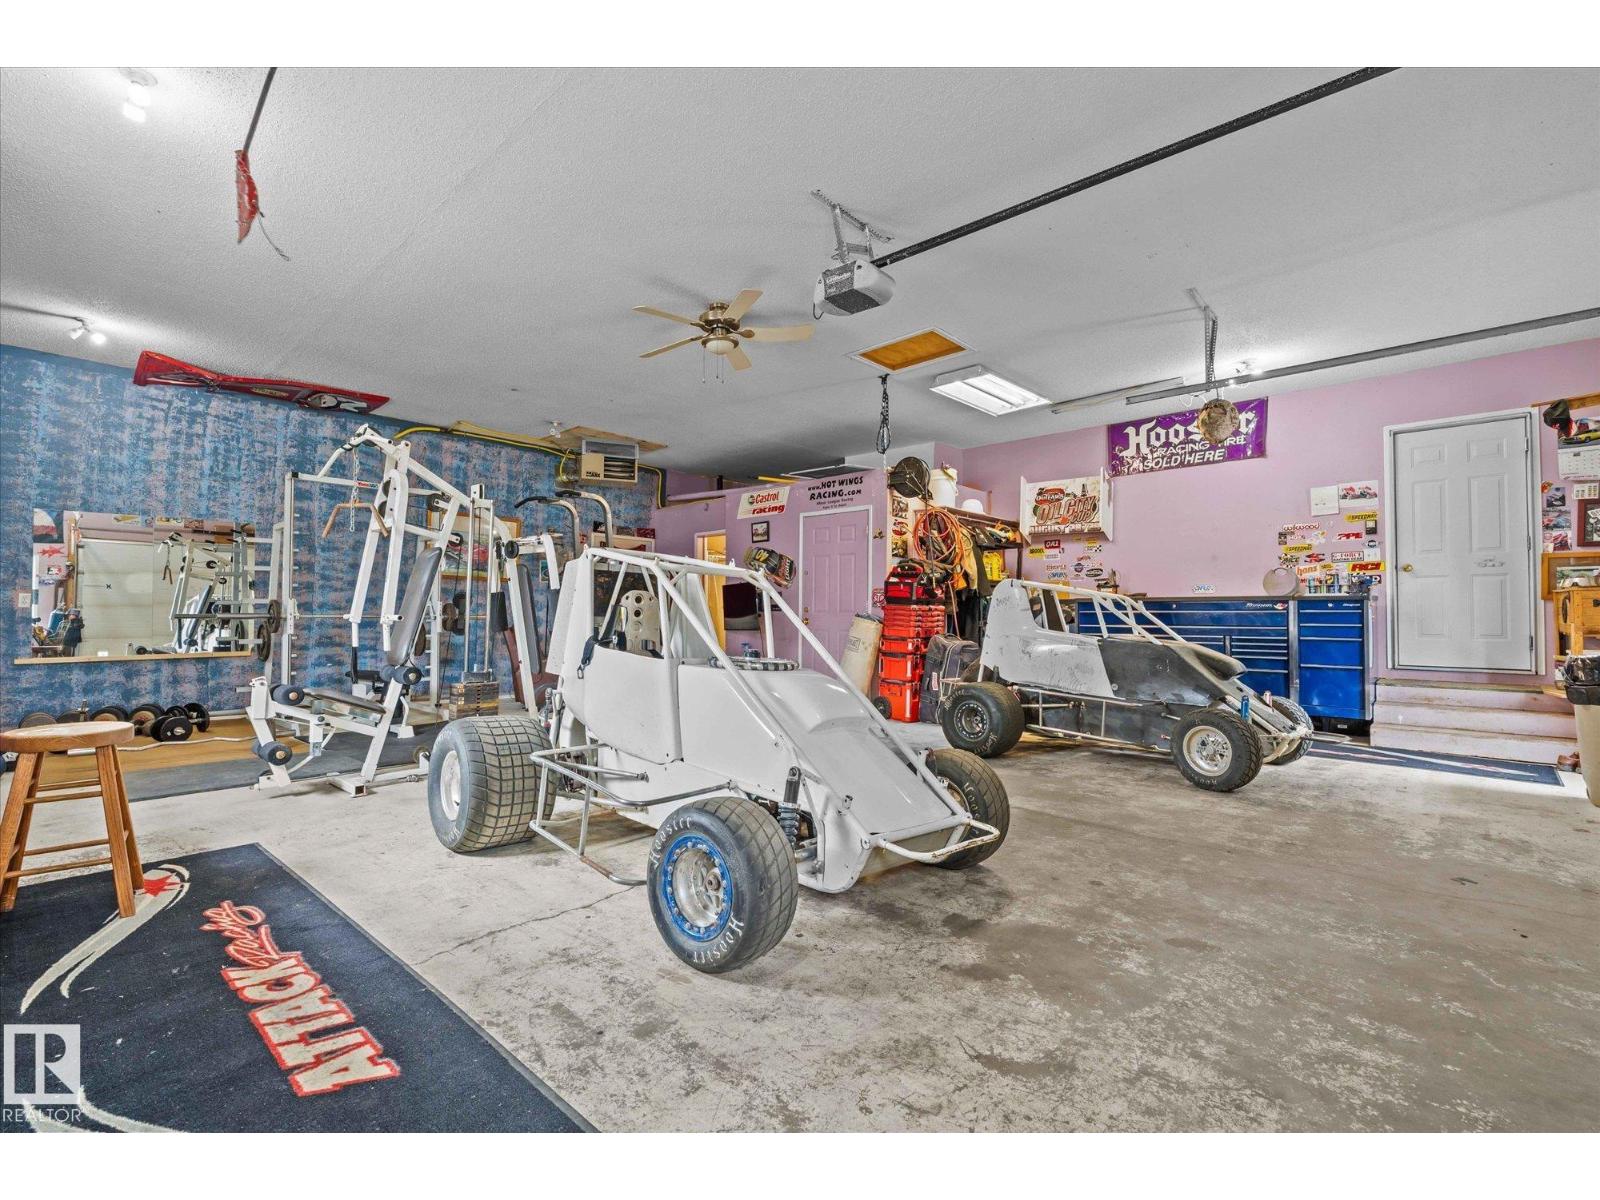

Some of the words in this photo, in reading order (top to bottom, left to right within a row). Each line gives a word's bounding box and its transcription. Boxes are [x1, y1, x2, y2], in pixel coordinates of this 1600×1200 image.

[1120, 410, 1256, 456] Hoosr
[1157, 440, 1210, 456] RACING
[1218, 434, 1246, 447] IRE
[1143, 456, 1181, 470] SOLD
[1185, 449, 1225, 464] HERE
[838, 476, 863, 486] WINGS
[755, 492, 779, 504] Castrol
[752, 504, 785, 515] racing
[650, 816, 692, 870] Hoosier
[693, 912, 745, 963] Hoosier
[220, 951, 401, 1097] ATTACK
